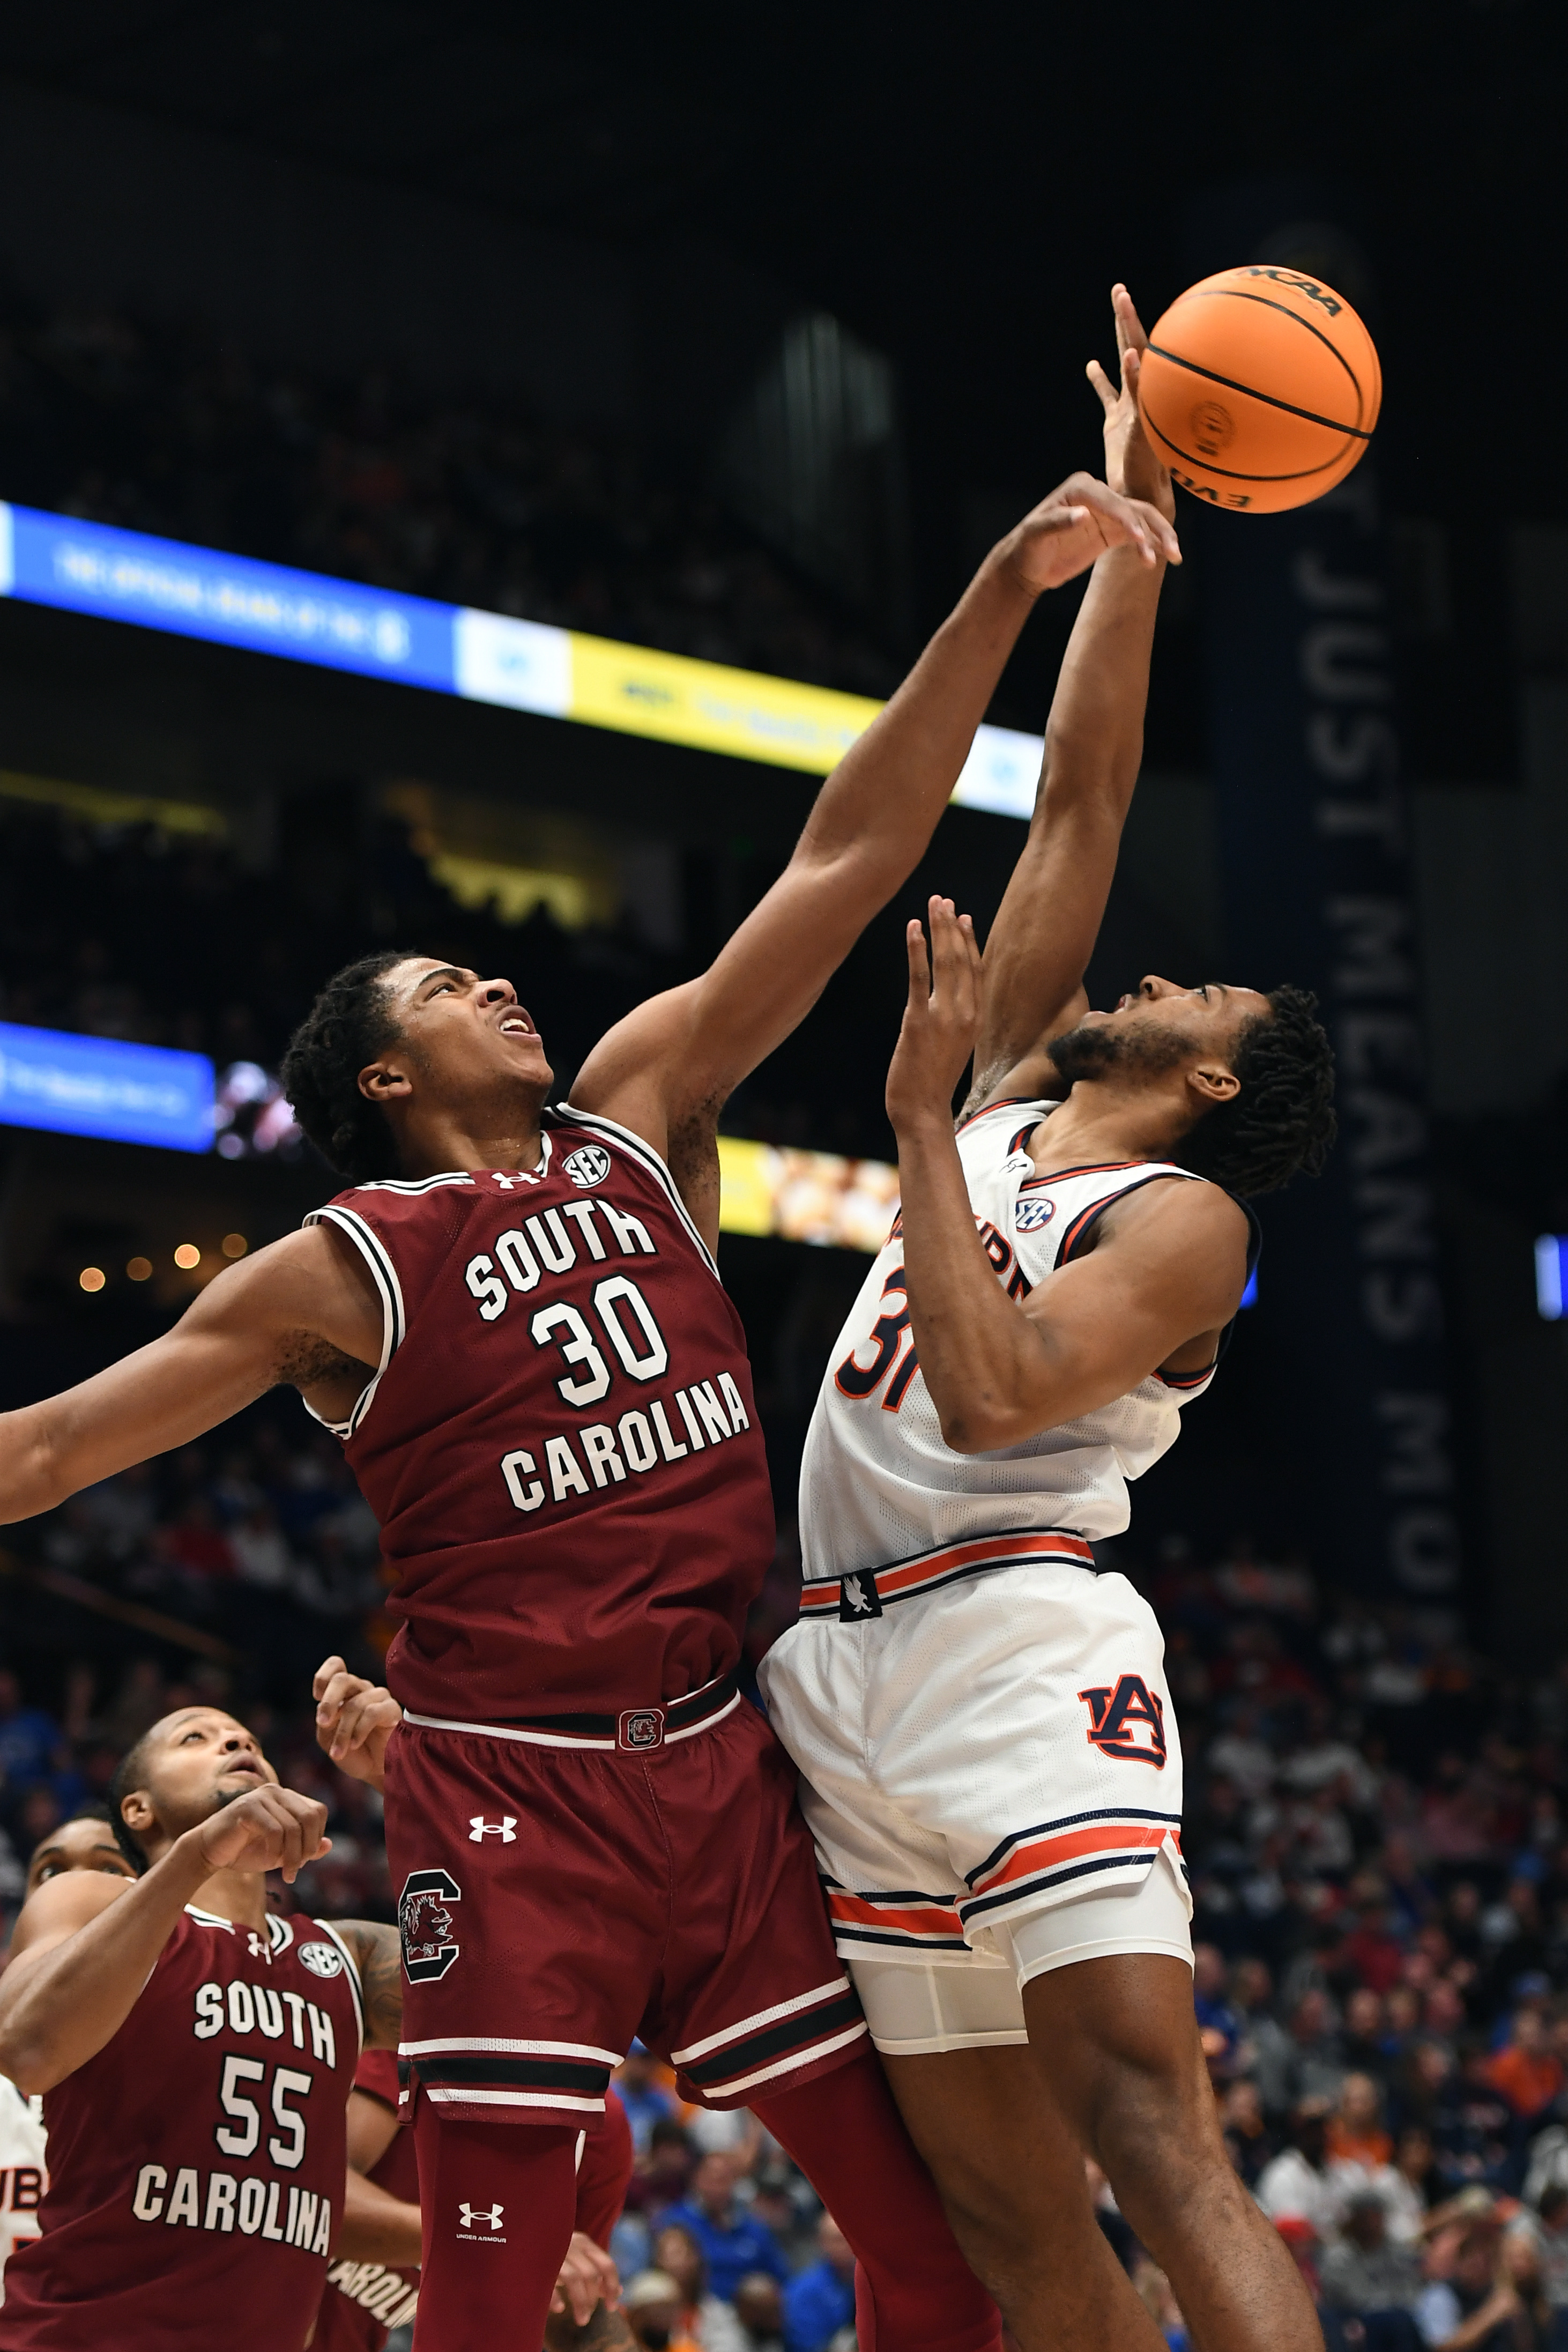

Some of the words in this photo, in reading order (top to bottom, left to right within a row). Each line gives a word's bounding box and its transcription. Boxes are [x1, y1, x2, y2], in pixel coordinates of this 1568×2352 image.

[1235, 268, 1342, 315] NCAA
[1291, 548, 1403, 860] JUST
[564, 1148, 607, 1185] SEC
[1325, 895, 1442, 1344] MEANS
[465, 1200, 657, 1320] SOUTH
[1015, 1198, 1054, 1230] SEC
[527, 1273, 670, 1409] 30
[501, 1371, 750, 1512] CAROLINA
[301, 1945, 339, 1975] SEC
[193, 1980, 336, 2069] SOUTH
[215, 2053, 313, 2169] 55
[132, 2164, 332, 2257] CAROLINA
